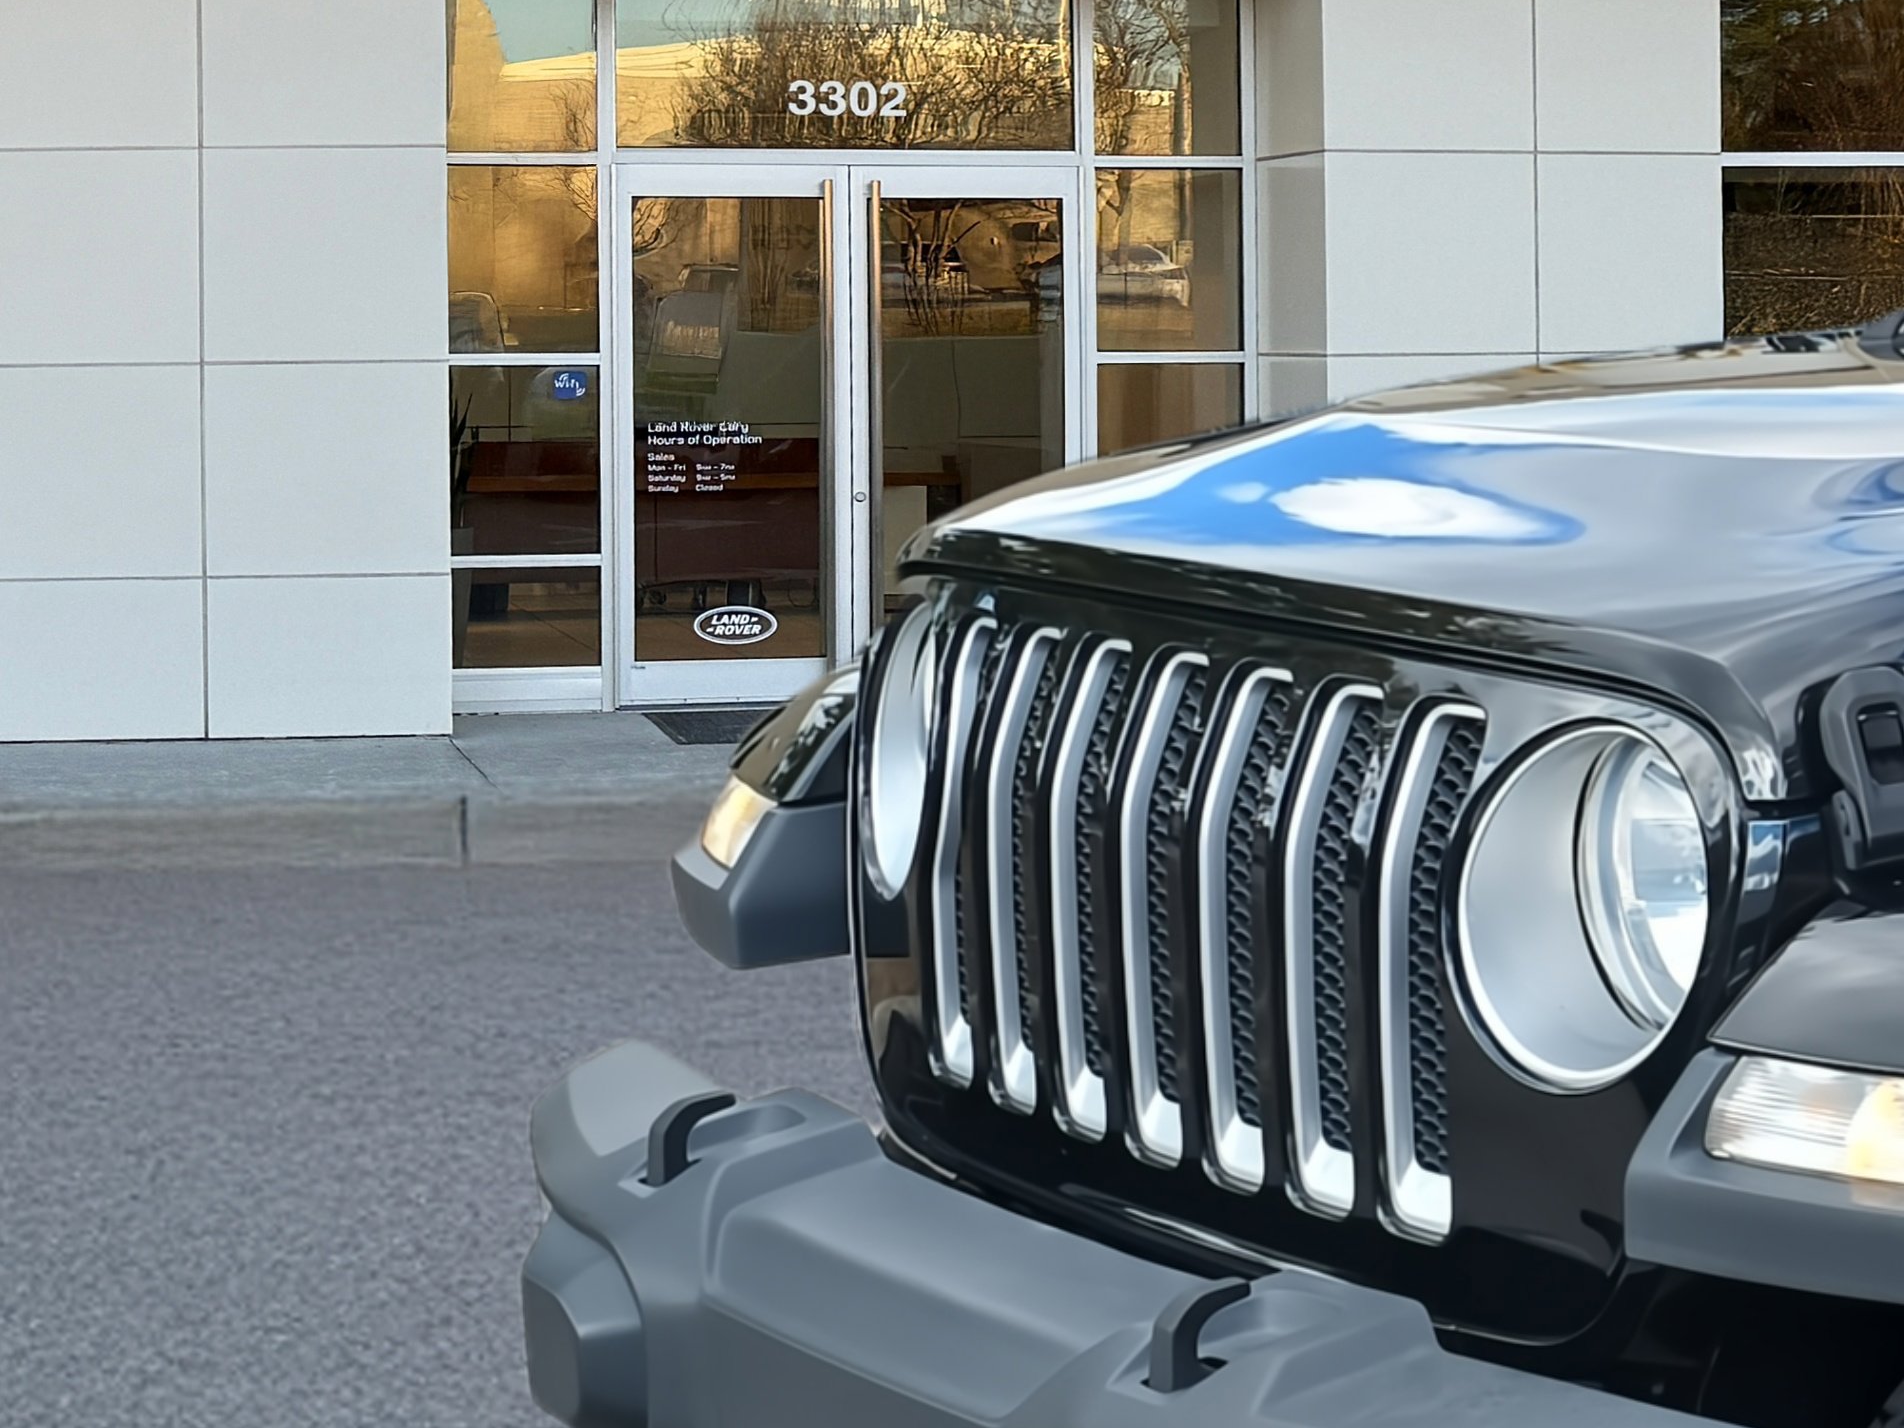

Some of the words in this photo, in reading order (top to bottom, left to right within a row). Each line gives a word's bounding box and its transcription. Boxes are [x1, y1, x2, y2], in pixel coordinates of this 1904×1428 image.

[787, 79, 907, 117] 3302
[647, 422, 677, 433] Land
[647, 435, 685, 446] Hours
[687, 434, 700, 445] of
[703, 435, 763, 447] Operation
[647, 453, 675, 461] Sales
[647, 474, 686, 483] Saturday
[647, 484, 679, 493] Sunday
[711, 614, 750, 625] LAND
[714, 624, 762, 636] ROVER
